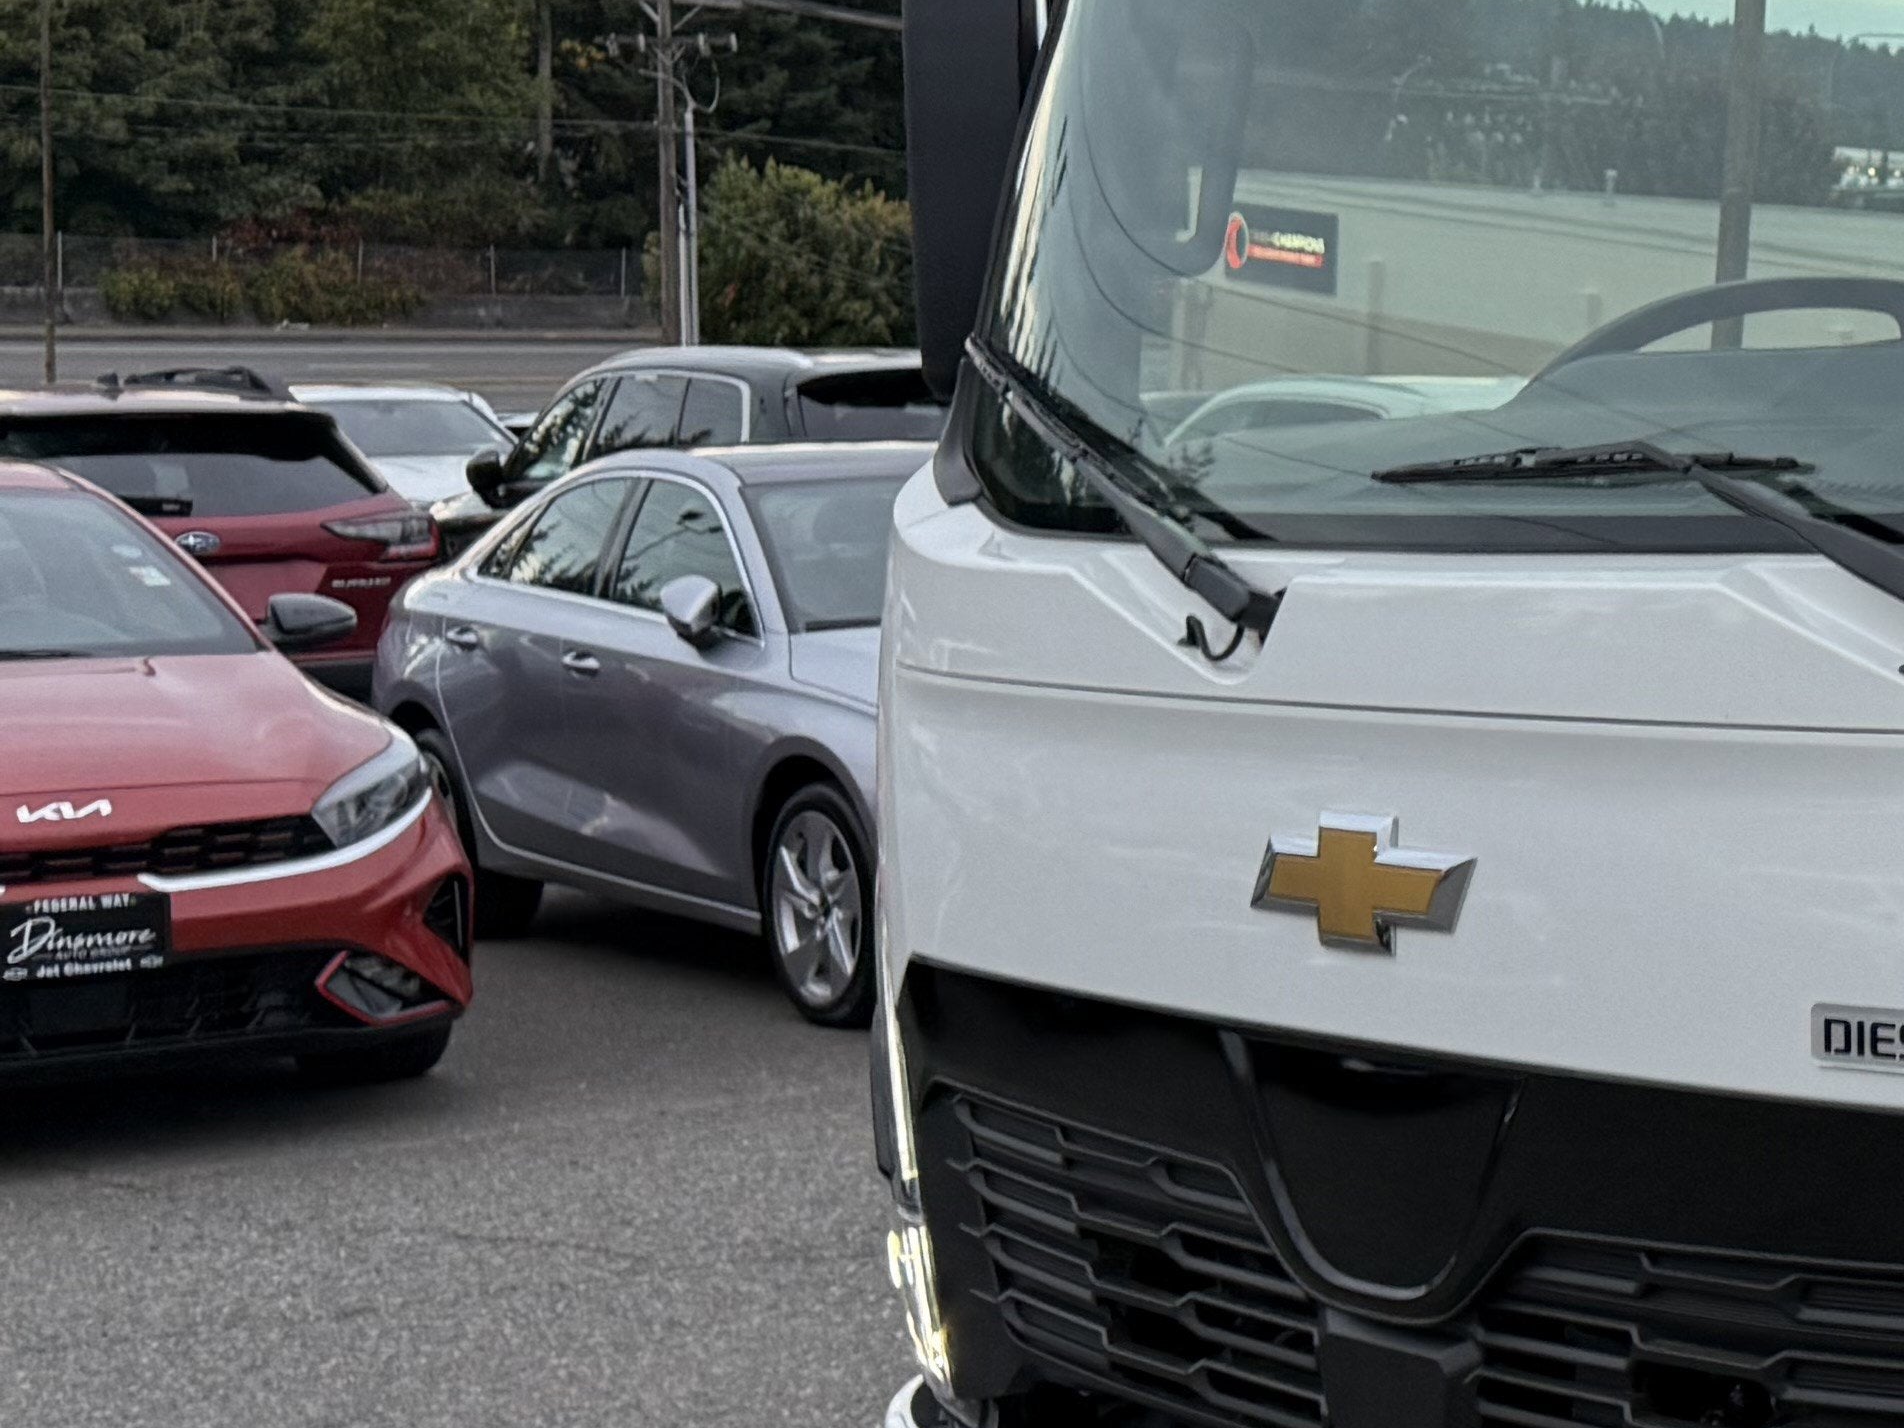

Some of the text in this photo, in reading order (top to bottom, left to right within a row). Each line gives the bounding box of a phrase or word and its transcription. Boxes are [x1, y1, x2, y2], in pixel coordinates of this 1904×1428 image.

[33, 892, 130, 914] FEDERAL WAY
[7, 916, 156, 964] Dinsmore
[36, 957, 133, 979] Jet Chevrolet
